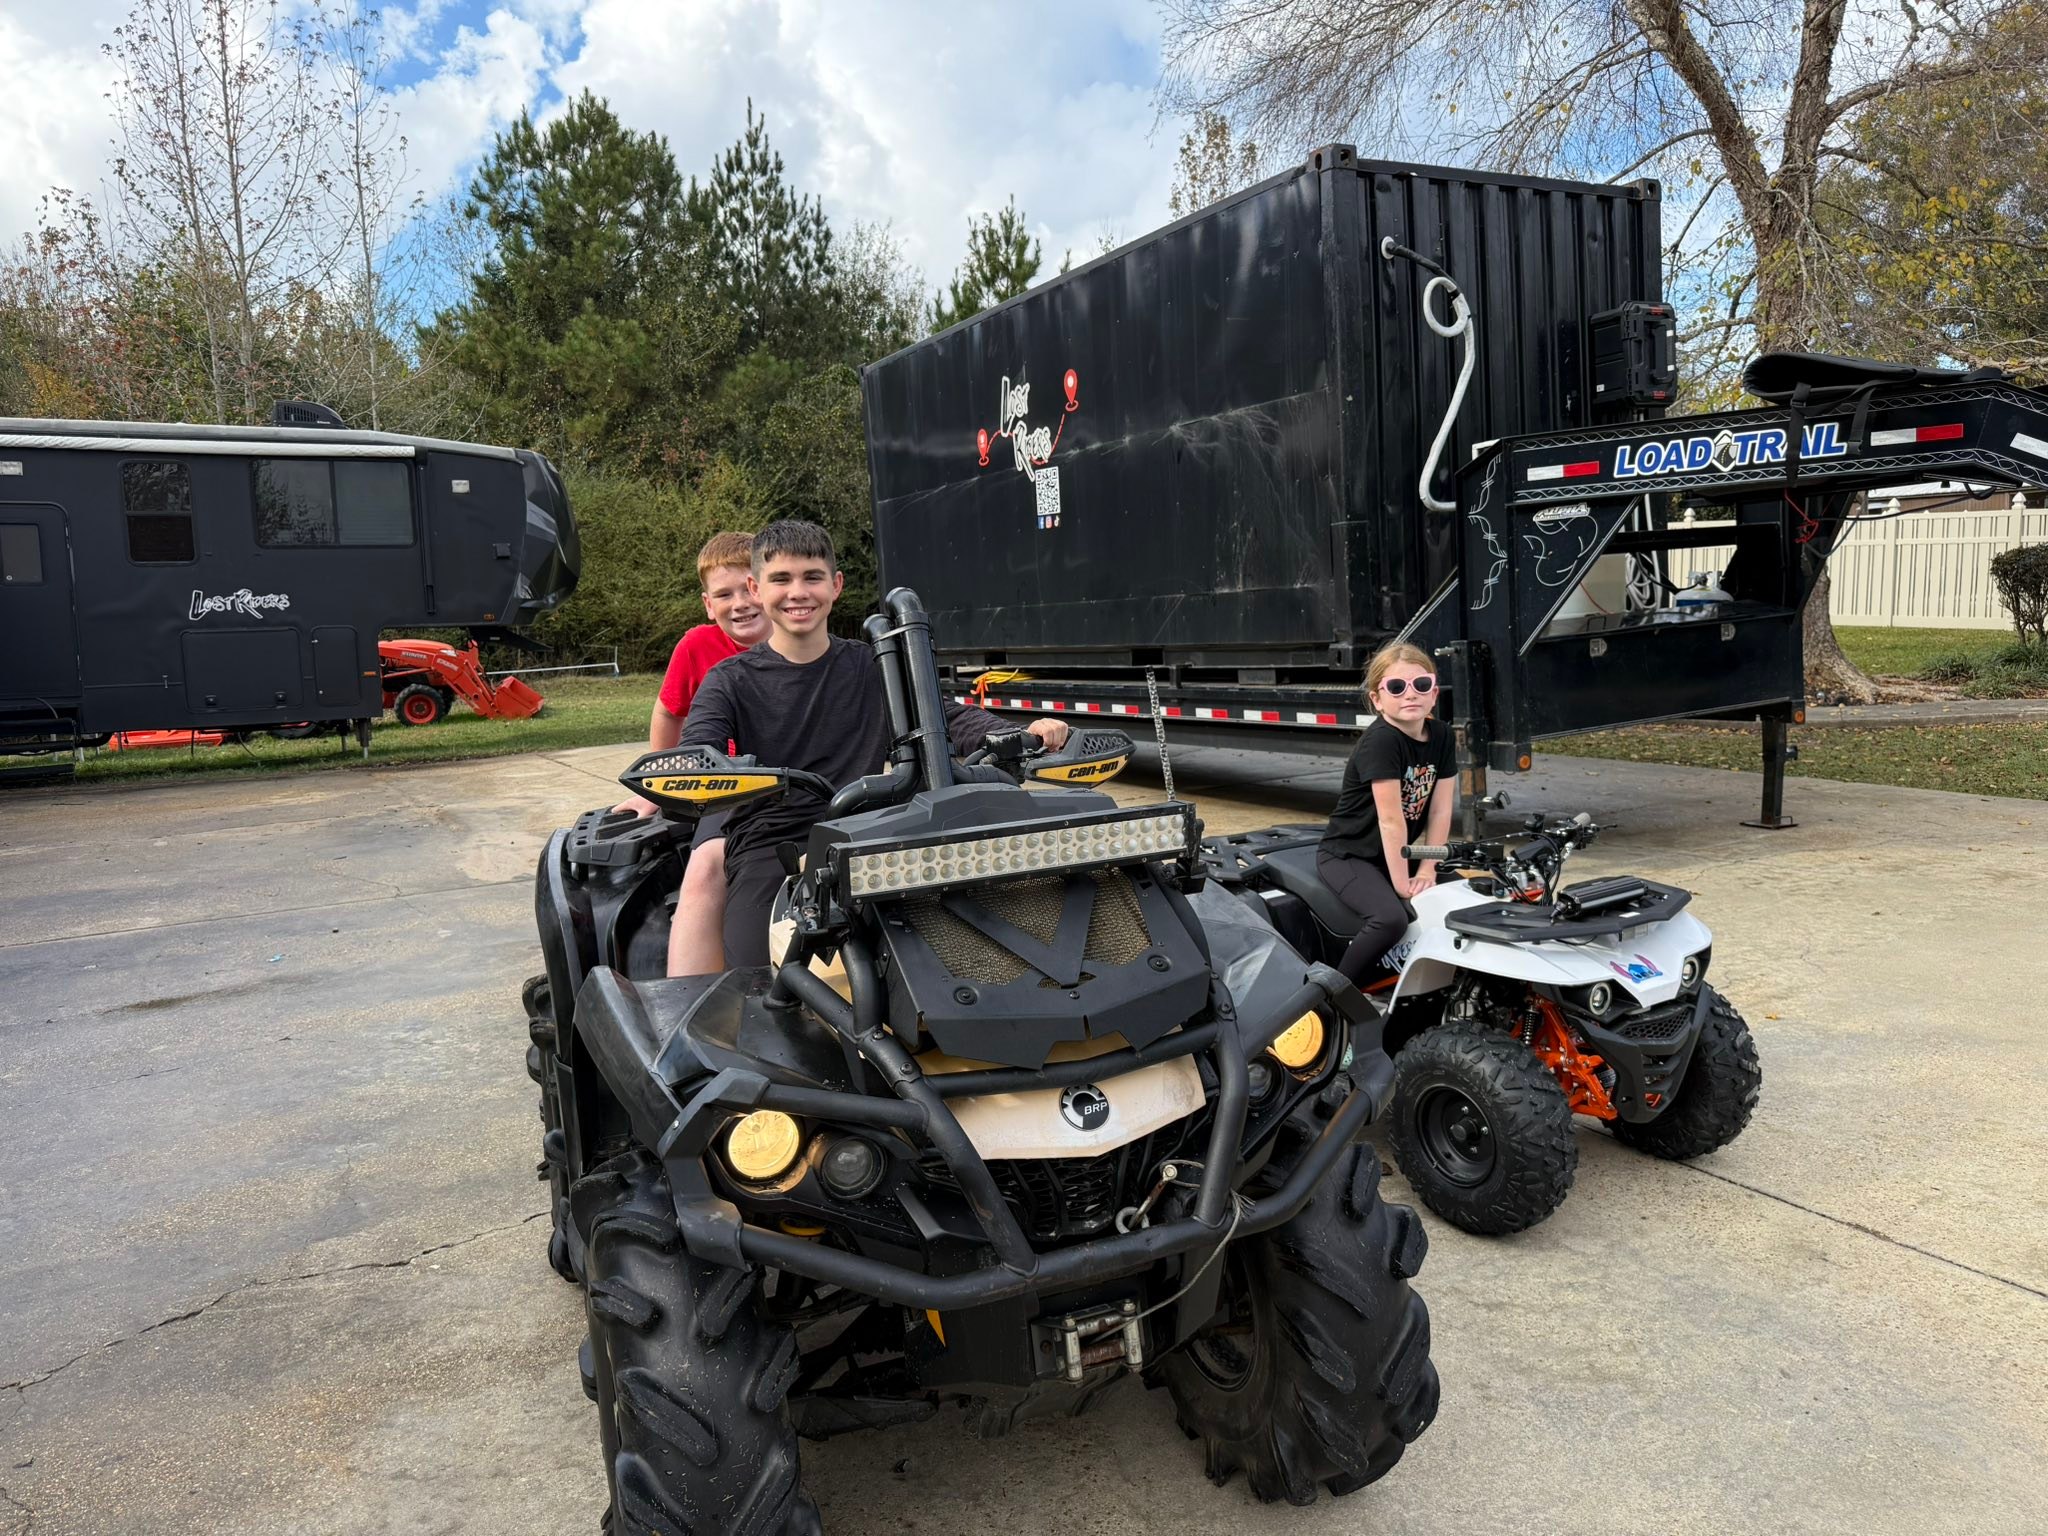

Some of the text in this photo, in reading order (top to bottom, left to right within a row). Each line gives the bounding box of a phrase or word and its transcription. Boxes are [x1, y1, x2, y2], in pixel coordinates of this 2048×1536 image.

[1613, 436, 1715, 479] LOAD
[1067, 760, 1120, 779] can-am
[662, 779, 739, 792] can-am
[1084, 1101, 1108, 1116] BRP
